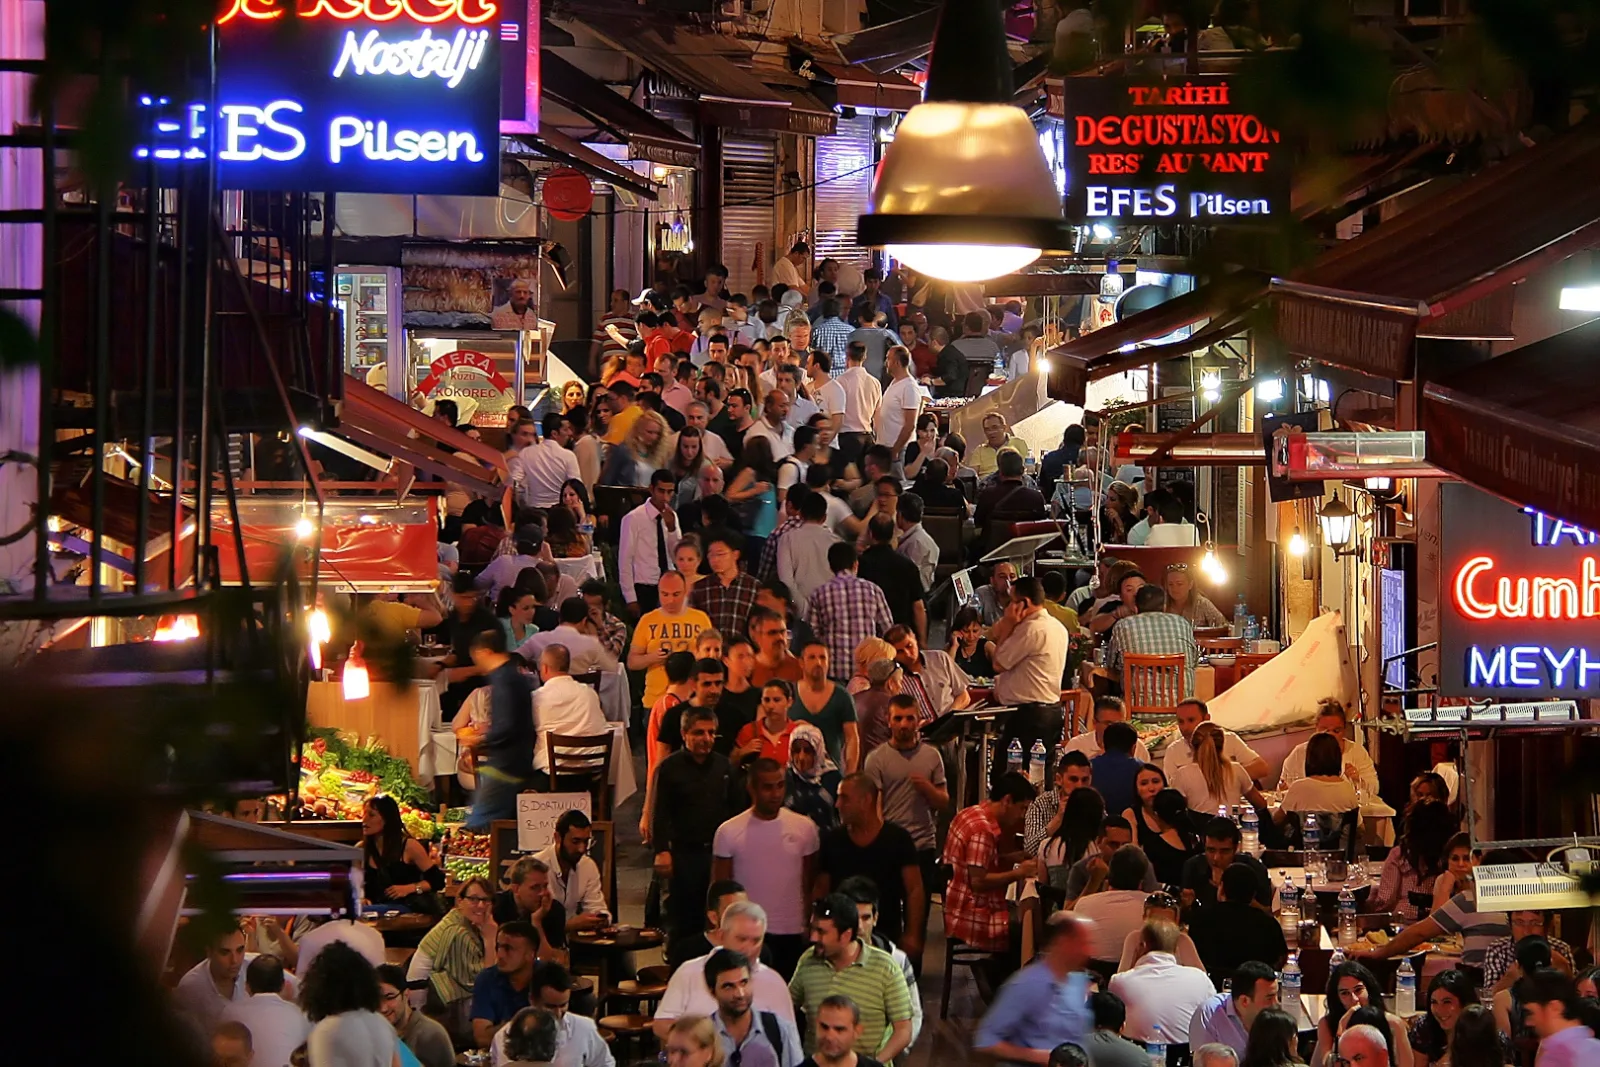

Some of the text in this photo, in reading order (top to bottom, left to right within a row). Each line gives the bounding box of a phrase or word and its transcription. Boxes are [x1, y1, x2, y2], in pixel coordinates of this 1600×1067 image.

[333, 27, 489, 89] Nostalji
[1128, 82, 1230, 105] TARİHİ
[329, 115, 484, 164] Pilsen
[1088, 152, 1270, 174] RESAURANT
[1086, 184, 1271, 218] EFES Pilsen
[434, 352, 491, 371] VERA
[649, 623, 702, 640] YARDS
